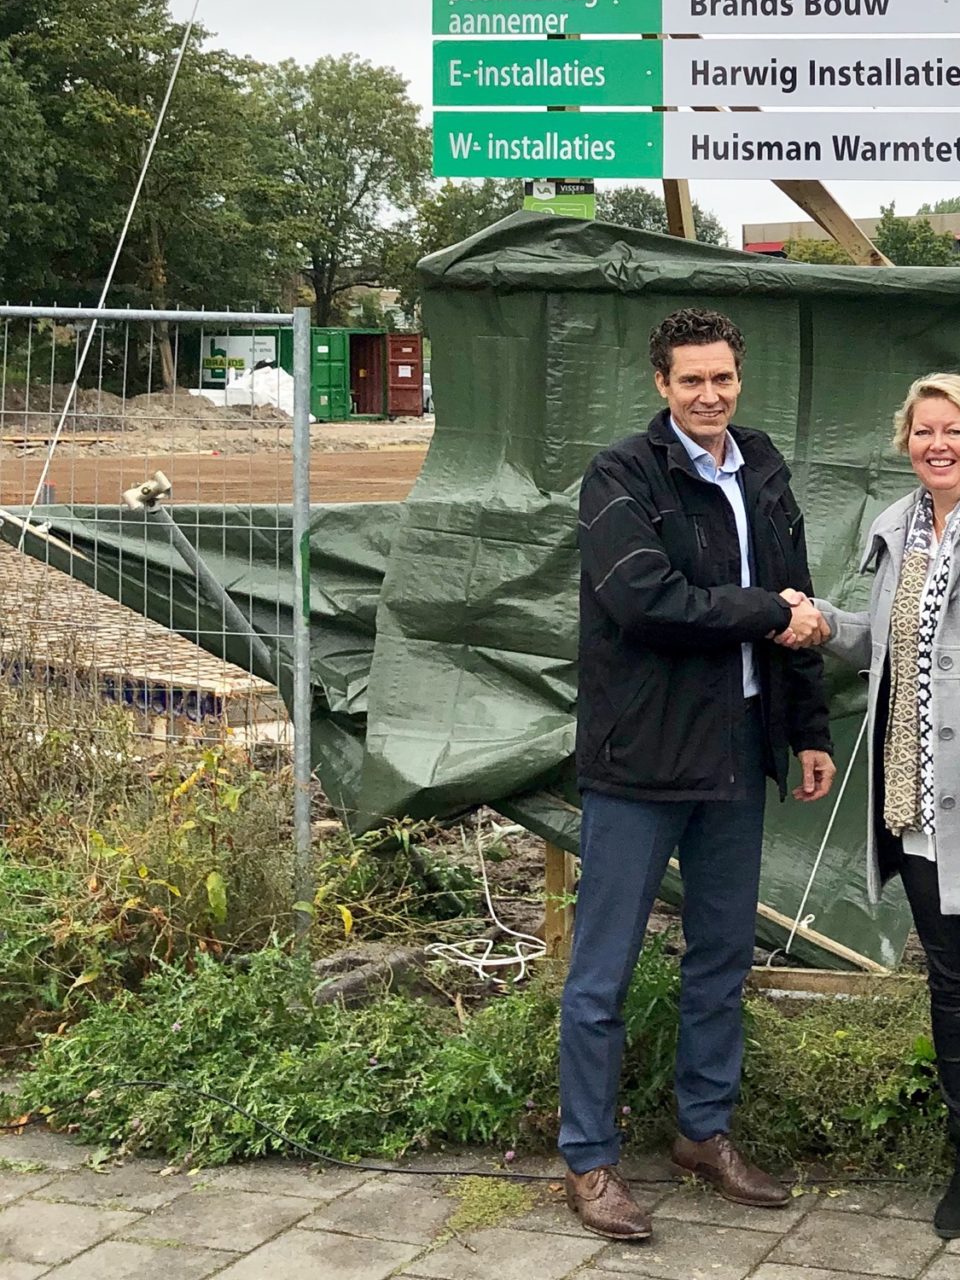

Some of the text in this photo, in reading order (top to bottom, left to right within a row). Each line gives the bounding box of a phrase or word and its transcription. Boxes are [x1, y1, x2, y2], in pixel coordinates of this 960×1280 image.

[448, 12, 569, 33] aannemer
[691, 57, 798, 92] Harwig
[449, 131, 616, 161] W- installaties
[692, 132, 822, 161] Huisman
